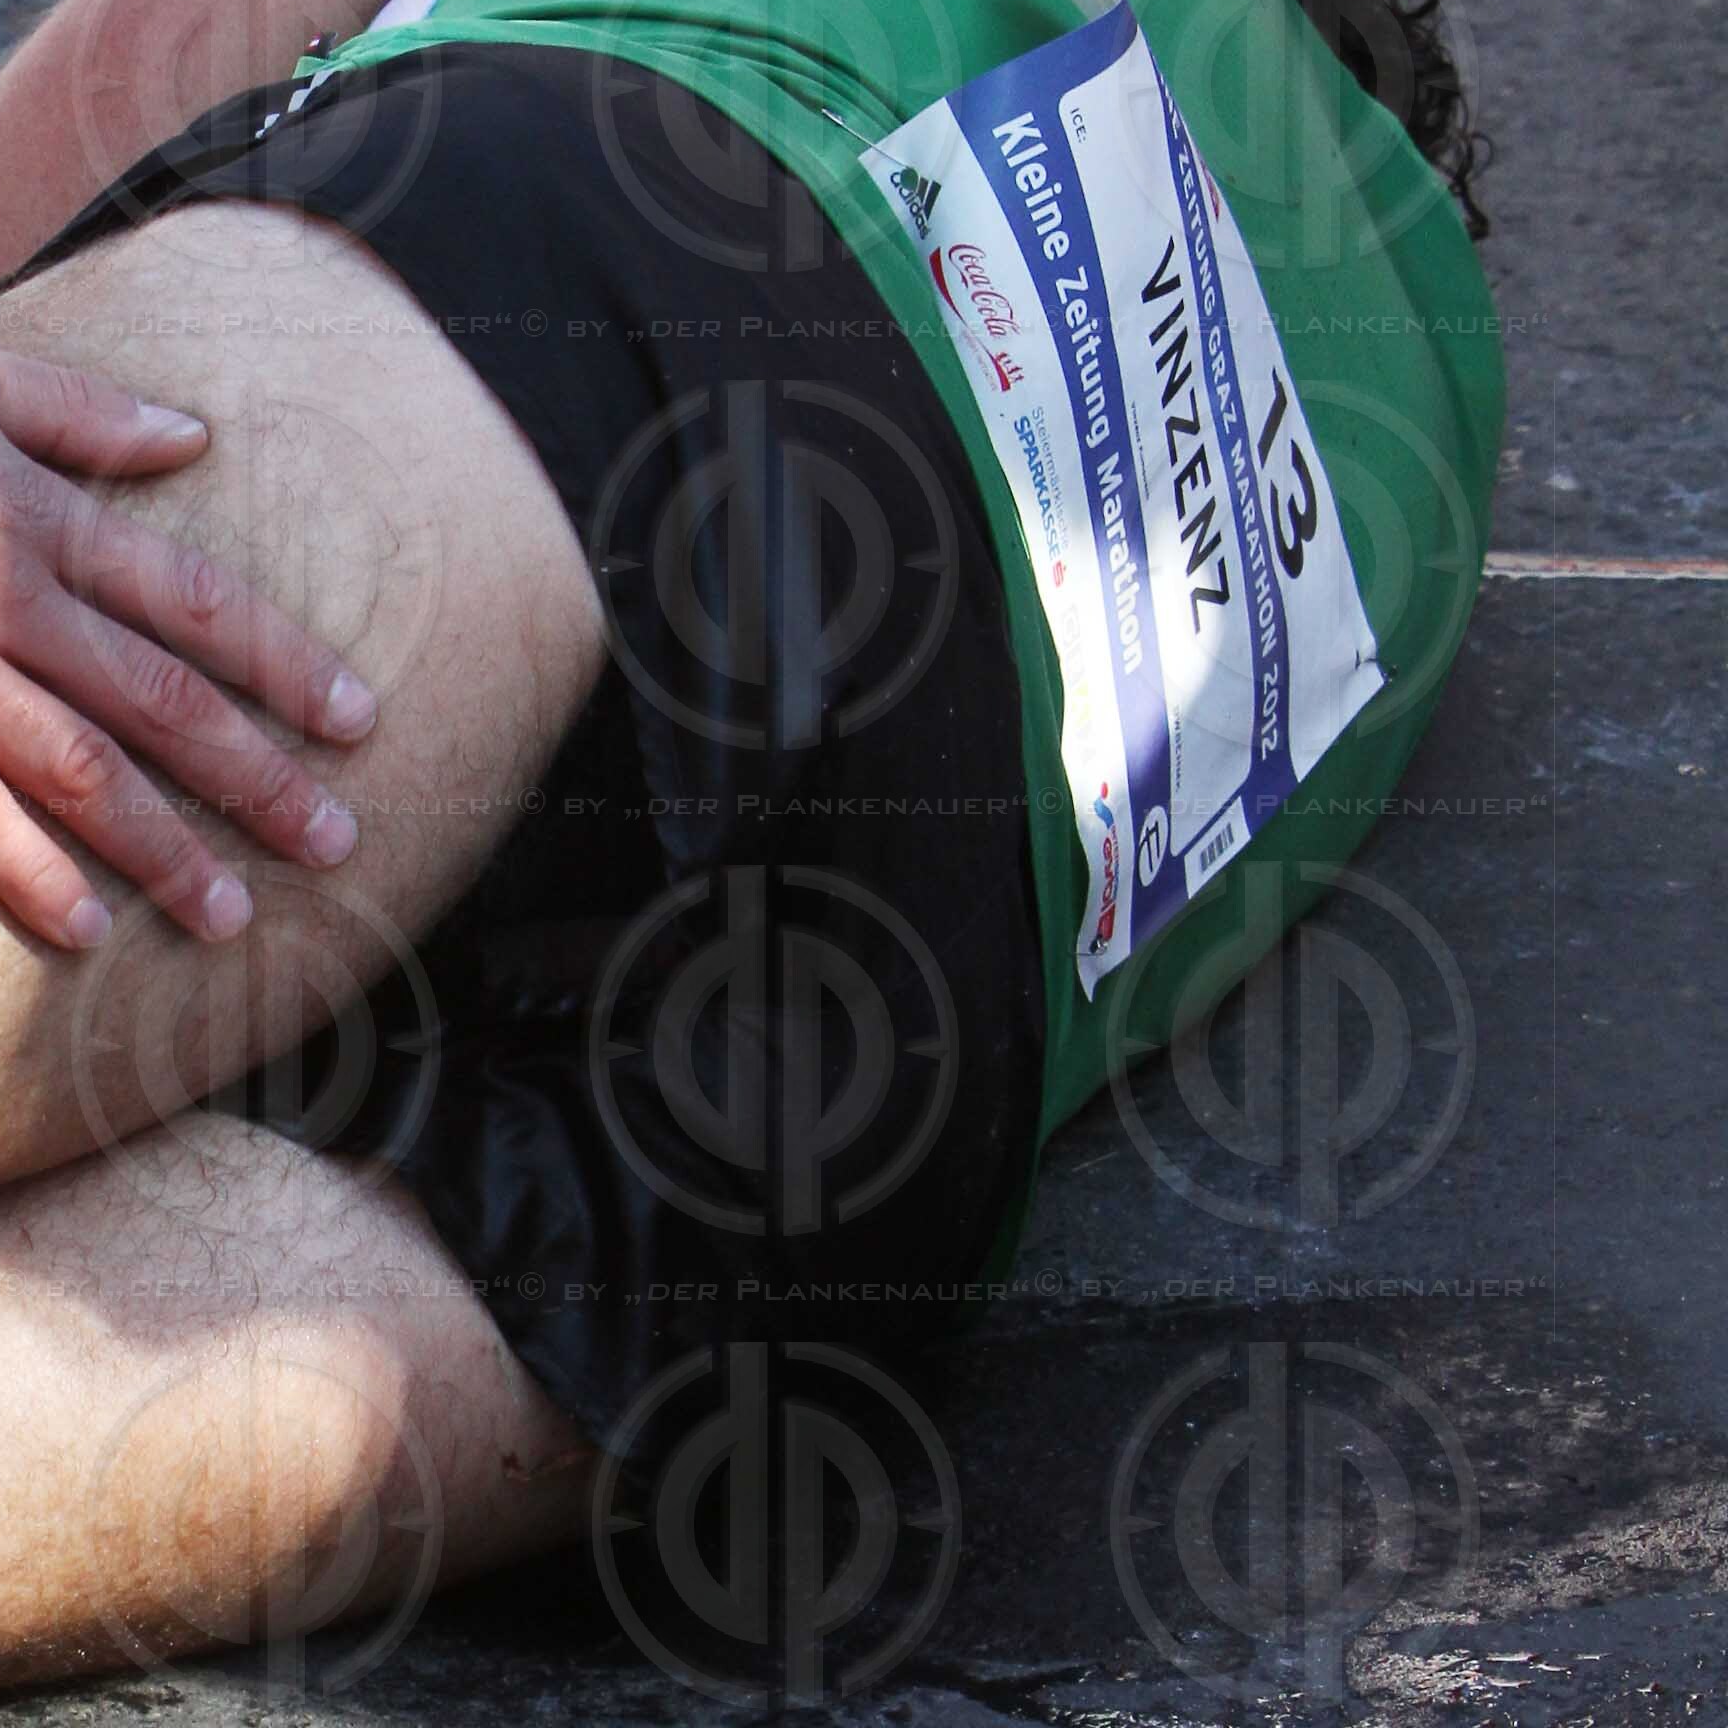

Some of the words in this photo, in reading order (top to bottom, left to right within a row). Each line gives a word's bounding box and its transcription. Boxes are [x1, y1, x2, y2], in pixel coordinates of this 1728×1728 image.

[992, 111, 1070, 262] Kleine
[1056, 266, 1111, 449] Zeitung
[1096, 451, 1144, 675] Marathon
[1013, 415, 1062, 561] SPARKASSE
[1140, 235, 1230, 635] VINZENZ
[1177, 142, 1216, 317] ZEITUNG
[1207, 324, 1238, 435] GRAZ
[1230, 438, 1278, 659] MARATHON
[1260, 660, 1279, 762] 2012
[1257, 368, 1318, 580] 13
